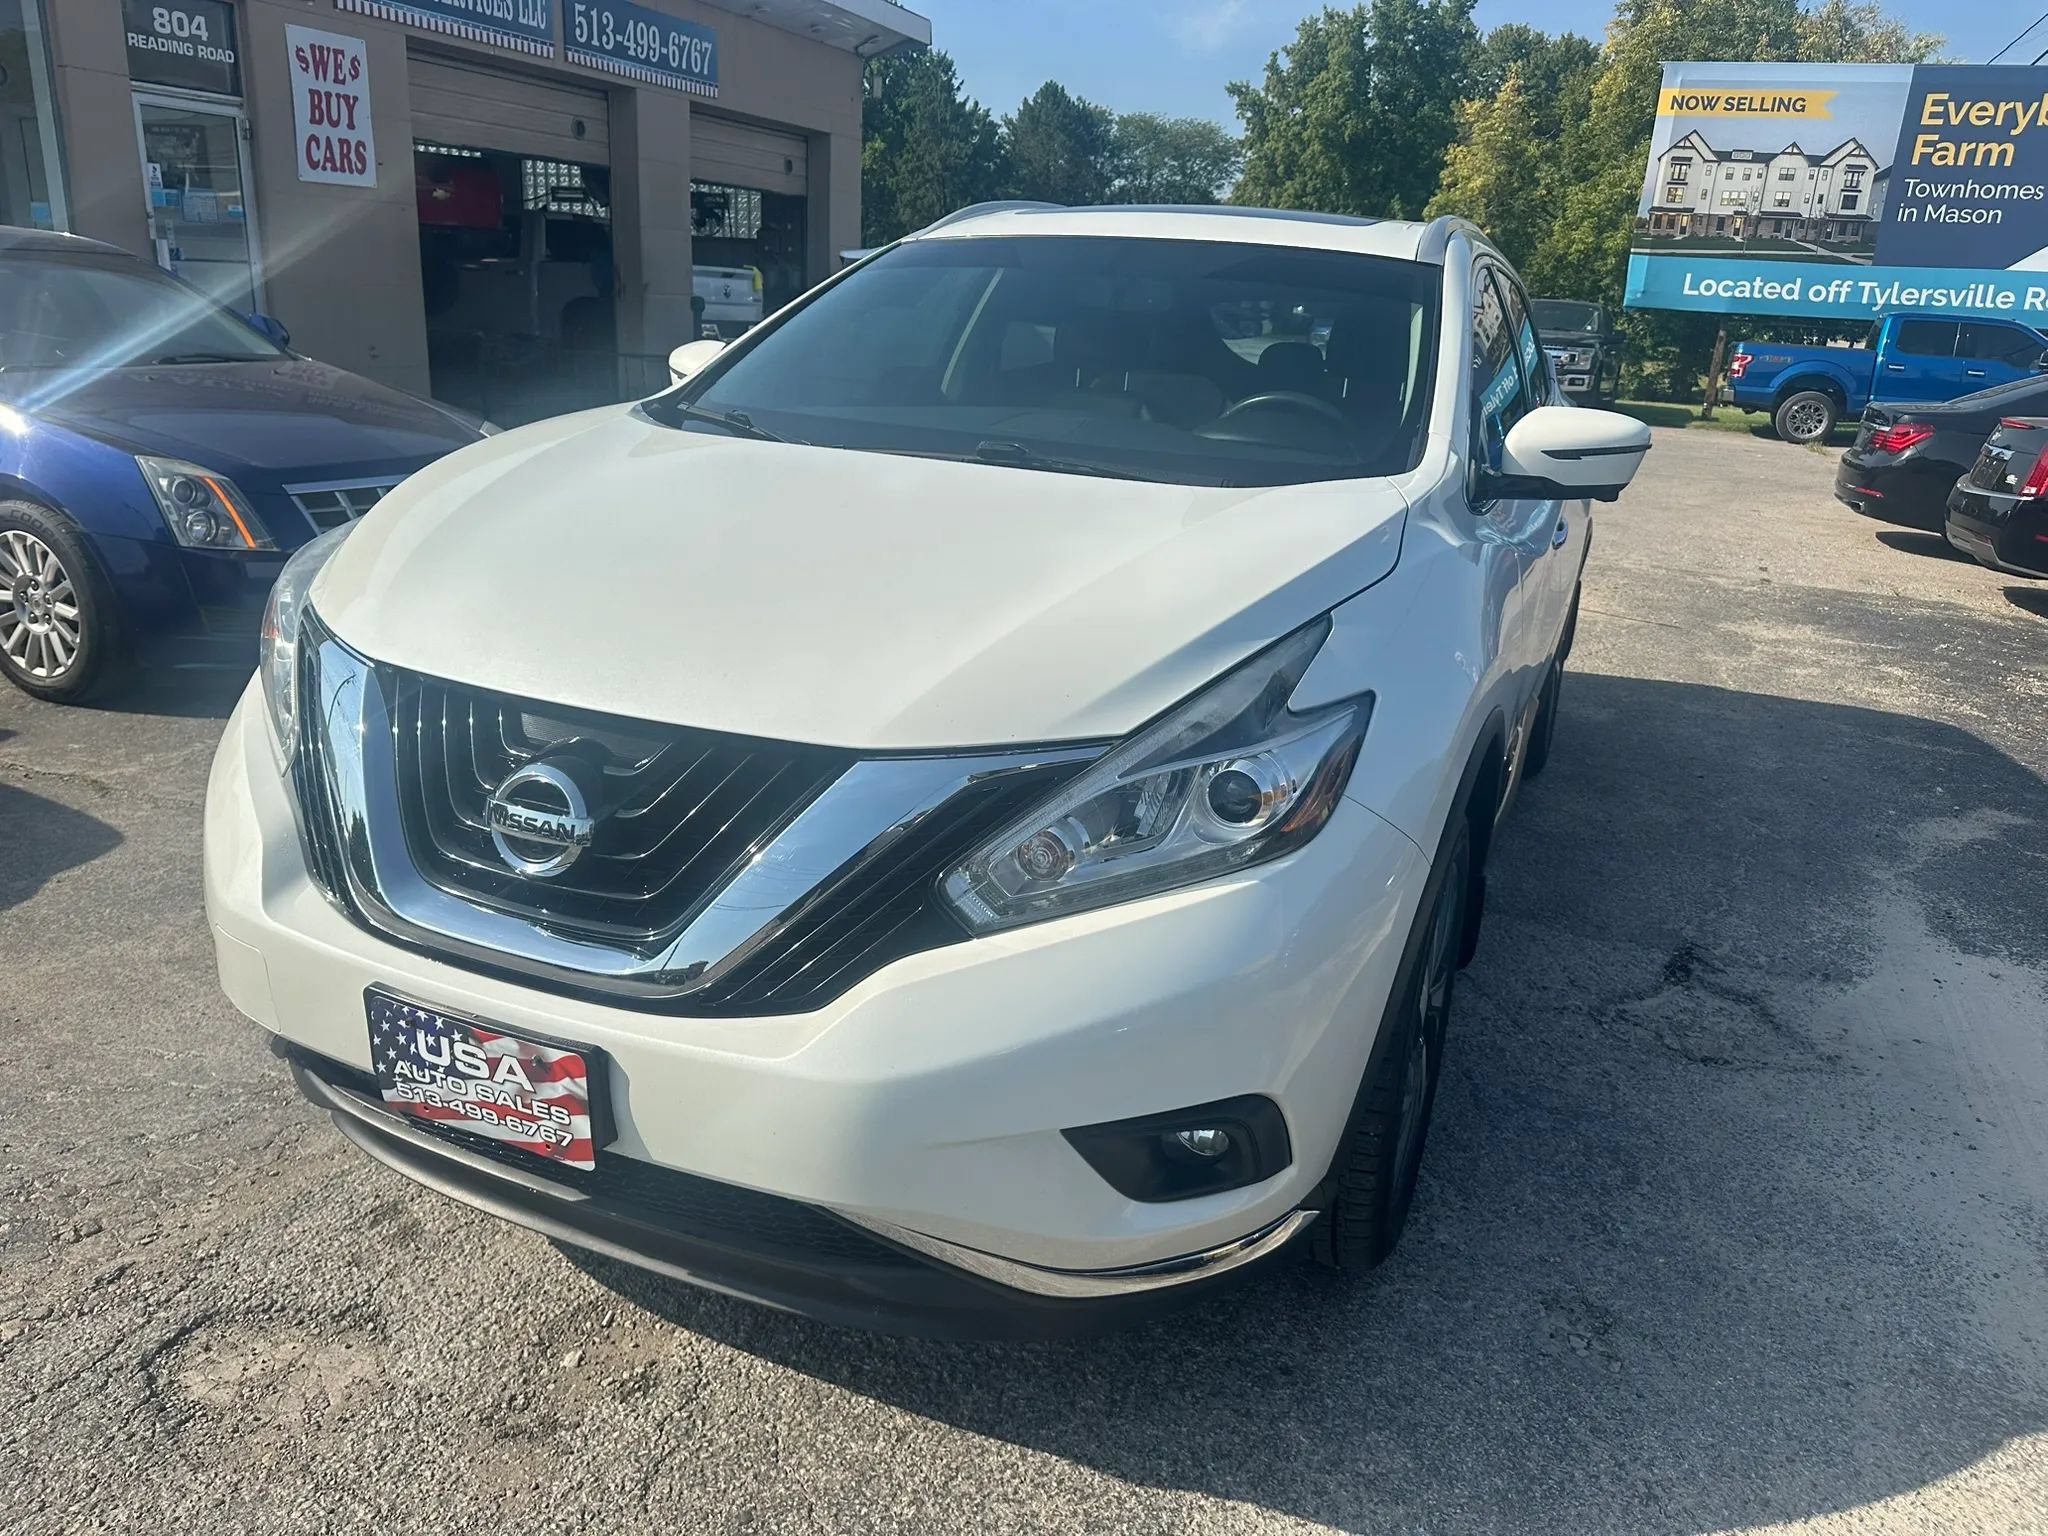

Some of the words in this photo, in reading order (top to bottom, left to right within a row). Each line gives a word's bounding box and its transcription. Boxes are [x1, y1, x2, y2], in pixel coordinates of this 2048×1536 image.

[152, 7, 208, 41] 804
[574, 2, 713, 75] 513-499-6767
[127, 32, 194, 56] READING
[197, 45, 235, 63] ROAD
[308, 87, 359, 130] BUY
[1670, 95, 1721, 111] NOW
[1723, 96, 1807, 113] SELLING
[305, 133, 367, 175] CARS
[1911, 134, 2015, 167] Farm
[1904, 178, 2045, 200] Townhomes
[1897, 203, 1917, 222] in
[1924, 203, 2003, 224] Mason
[1683, 273, 1802, 300] Located
[1808, 279, 1853, 304] off
[1857, 281, 2016, 312] Tylersville
[2023, 286, 2048, 311] R
[490, 802, 576, 842] NISSAN
[415, 1028, 536, 1094] USA
[393, 1060, 468, 1096] AUTO
[475, 1083, 572, 1126] SALES
